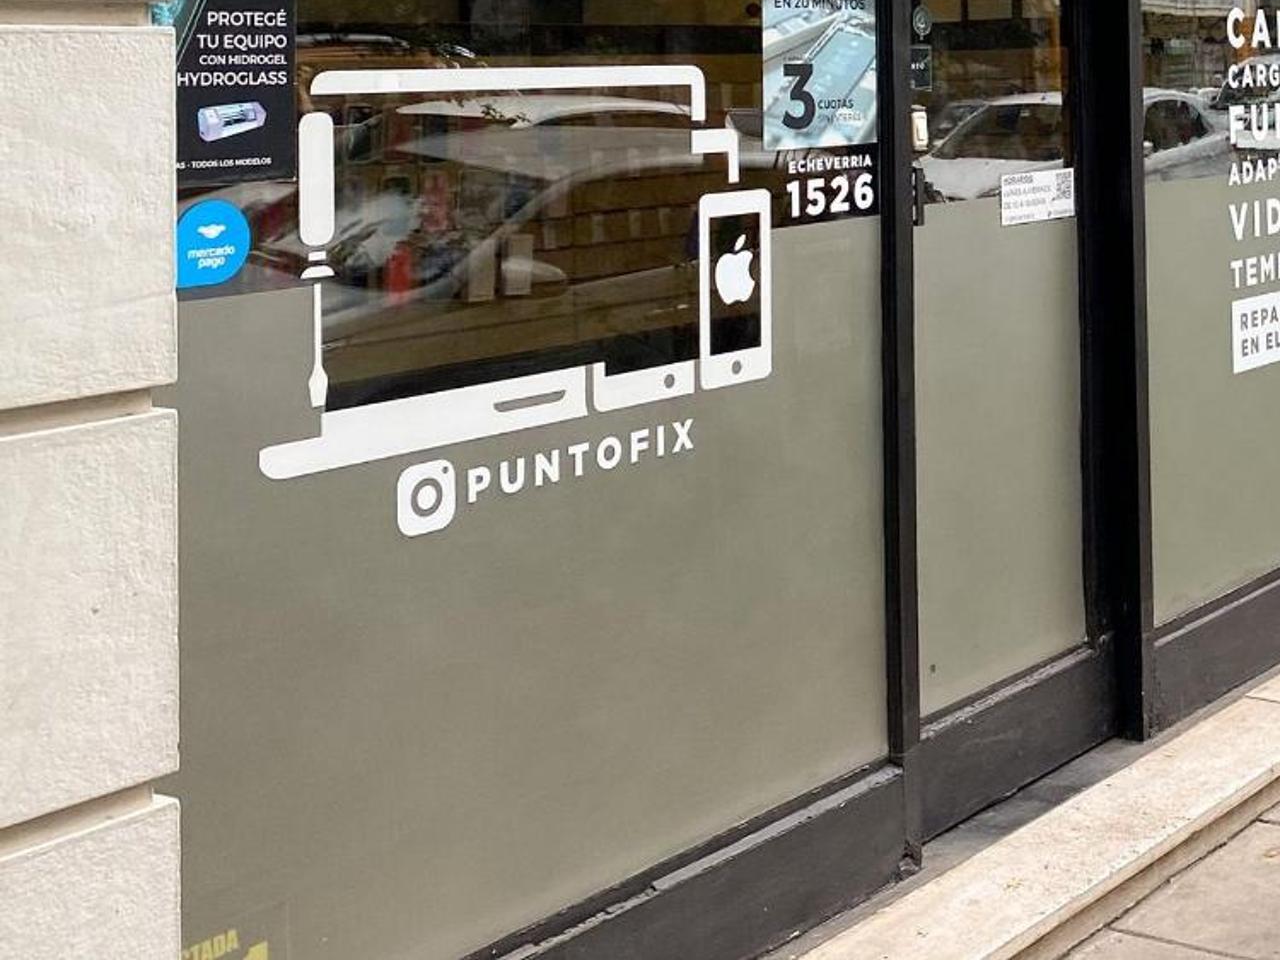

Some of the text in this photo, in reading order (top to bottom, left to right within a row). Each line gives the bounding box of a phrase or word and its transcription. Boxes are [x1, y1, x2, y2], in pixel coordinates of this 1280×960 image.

[207, 9, 287, 27] PROTEGÉ
[197, 34, 287, 51] TU EQUIPO
[199, 54, 287, 65] CON HIDROGEL
[177, 72, 287, 87] HYDROGLASS
[782, 64, 854, 129] 3 CUOTAS
[220, 159, 234, 167] LOS
[235, 157, 272, 166] MODELOS
[788, 154, 872, 174] ECHEVERRIA
[786, 173, 874, 218] 1526
[187, 245, 235, 259] mercado
[198, 256, 226, 269] pago
[1242, 338, 1259, 357] EN
[1266, 334, 1280, 350] EL
[467, 418, 694, 503] PUNTOFIX
